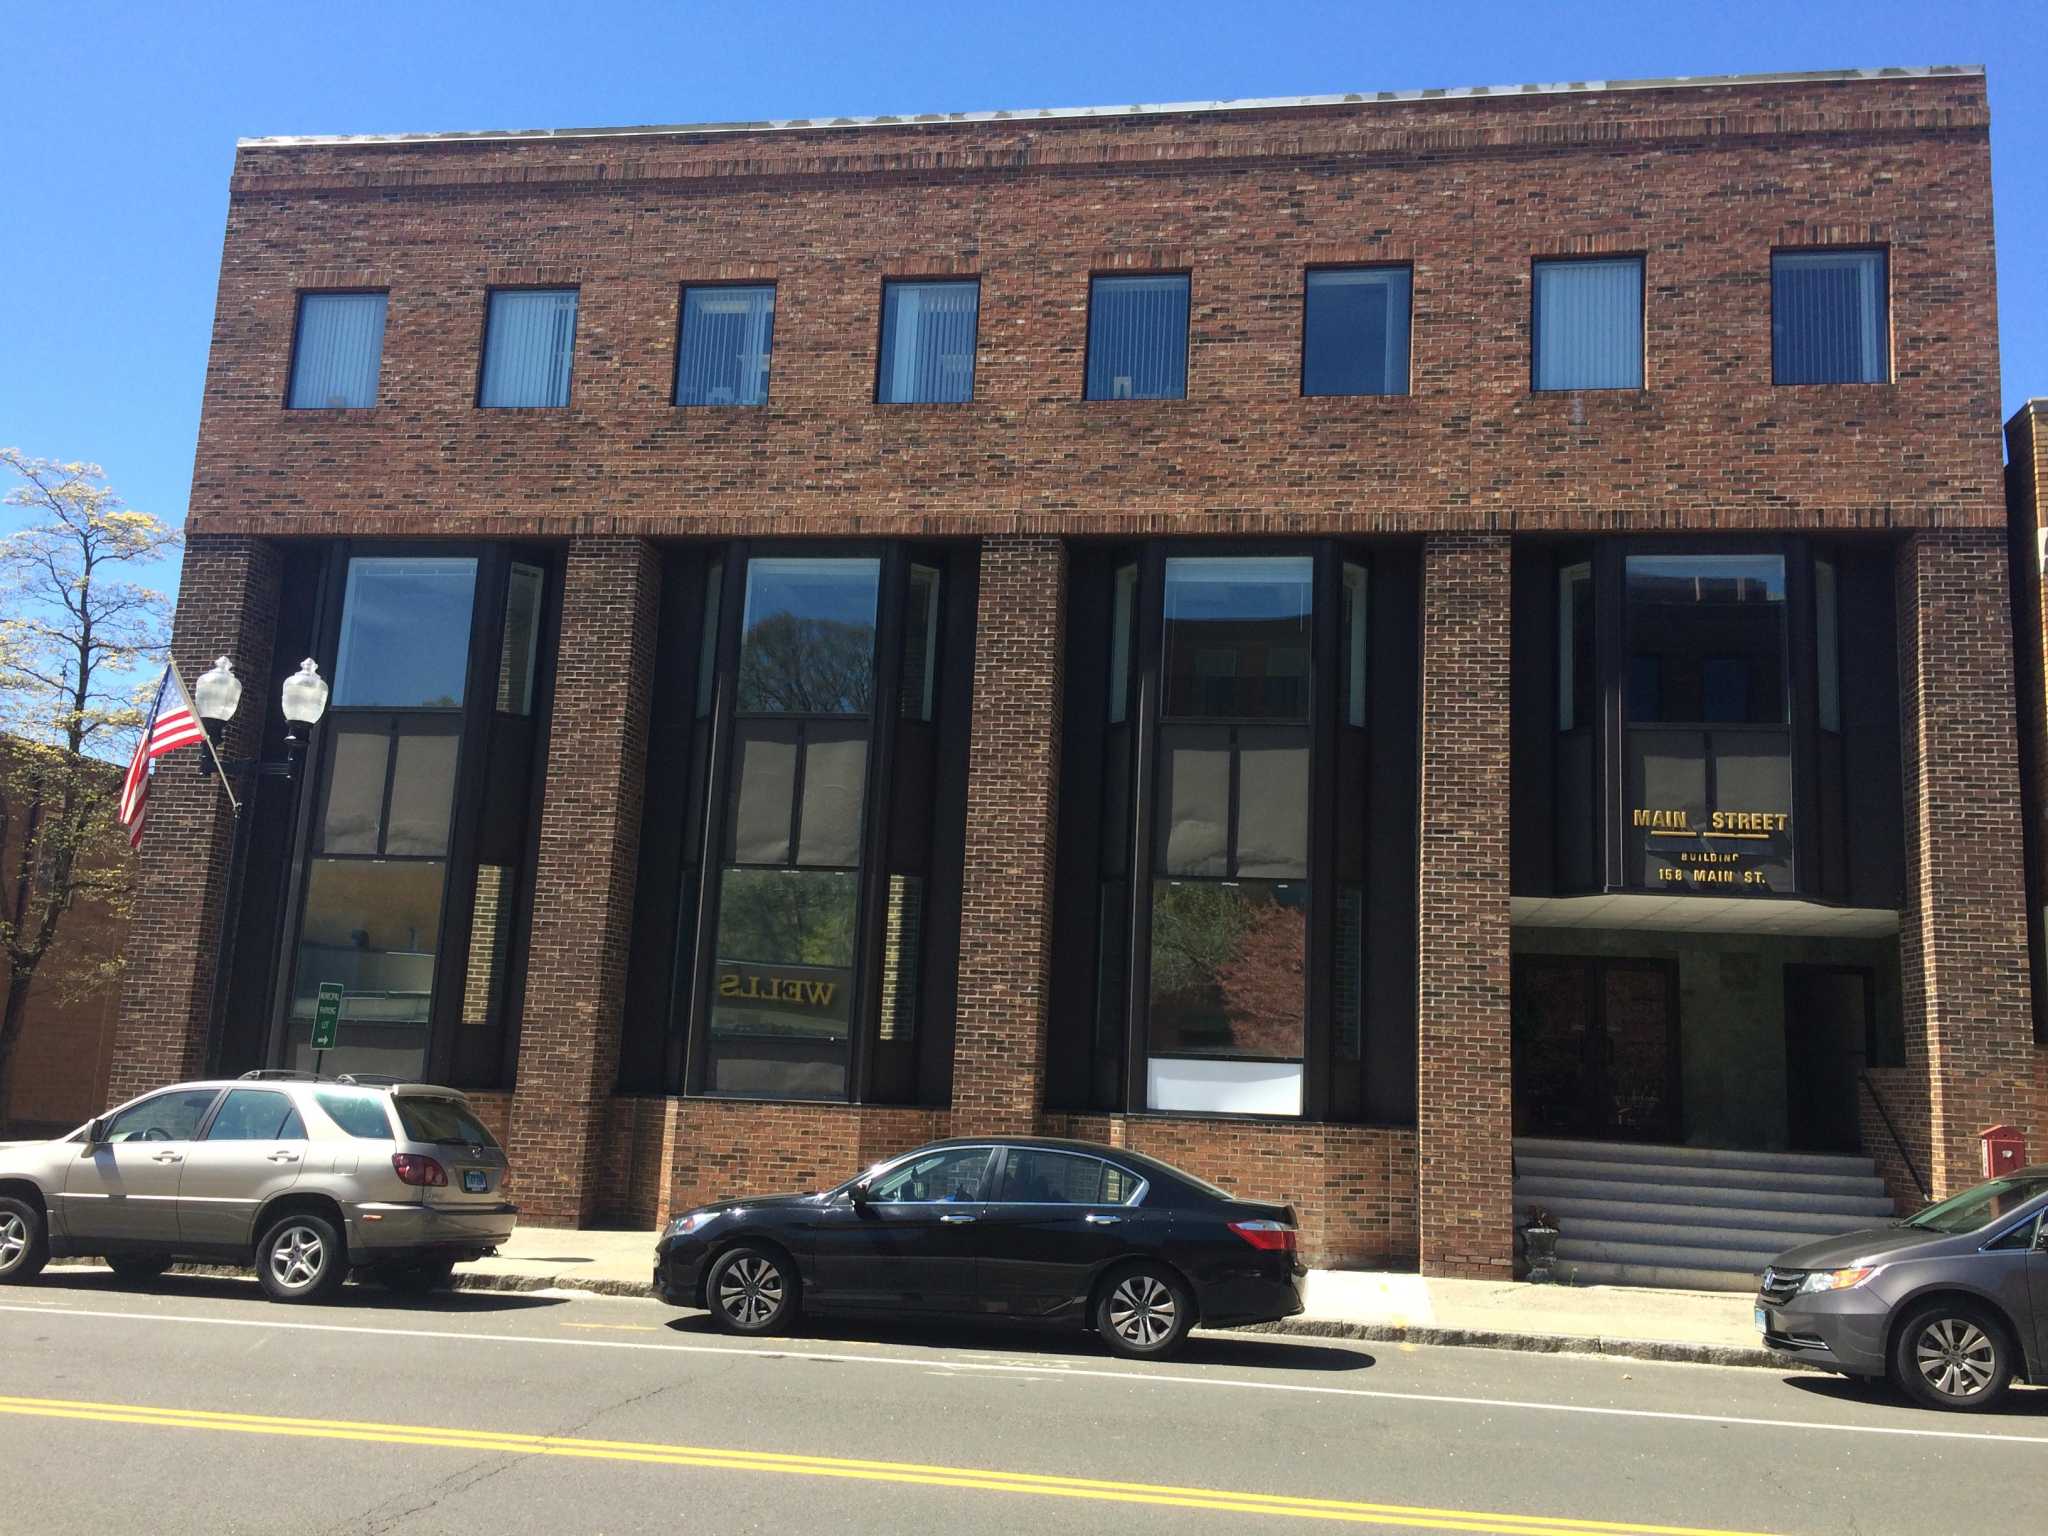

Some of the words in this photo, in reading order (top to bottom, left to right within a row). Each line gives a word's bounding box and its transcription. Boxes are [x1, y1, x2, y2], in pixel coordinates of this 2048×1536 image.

[1634, 809, 1687, 828] MAIN
[1712, 811, 1788, 831] STREET
[1658, 868, 1683, 881] 158
[1693, 869, 1733, 882] MAIN
[1743, 871, 1766, 884] ST.
